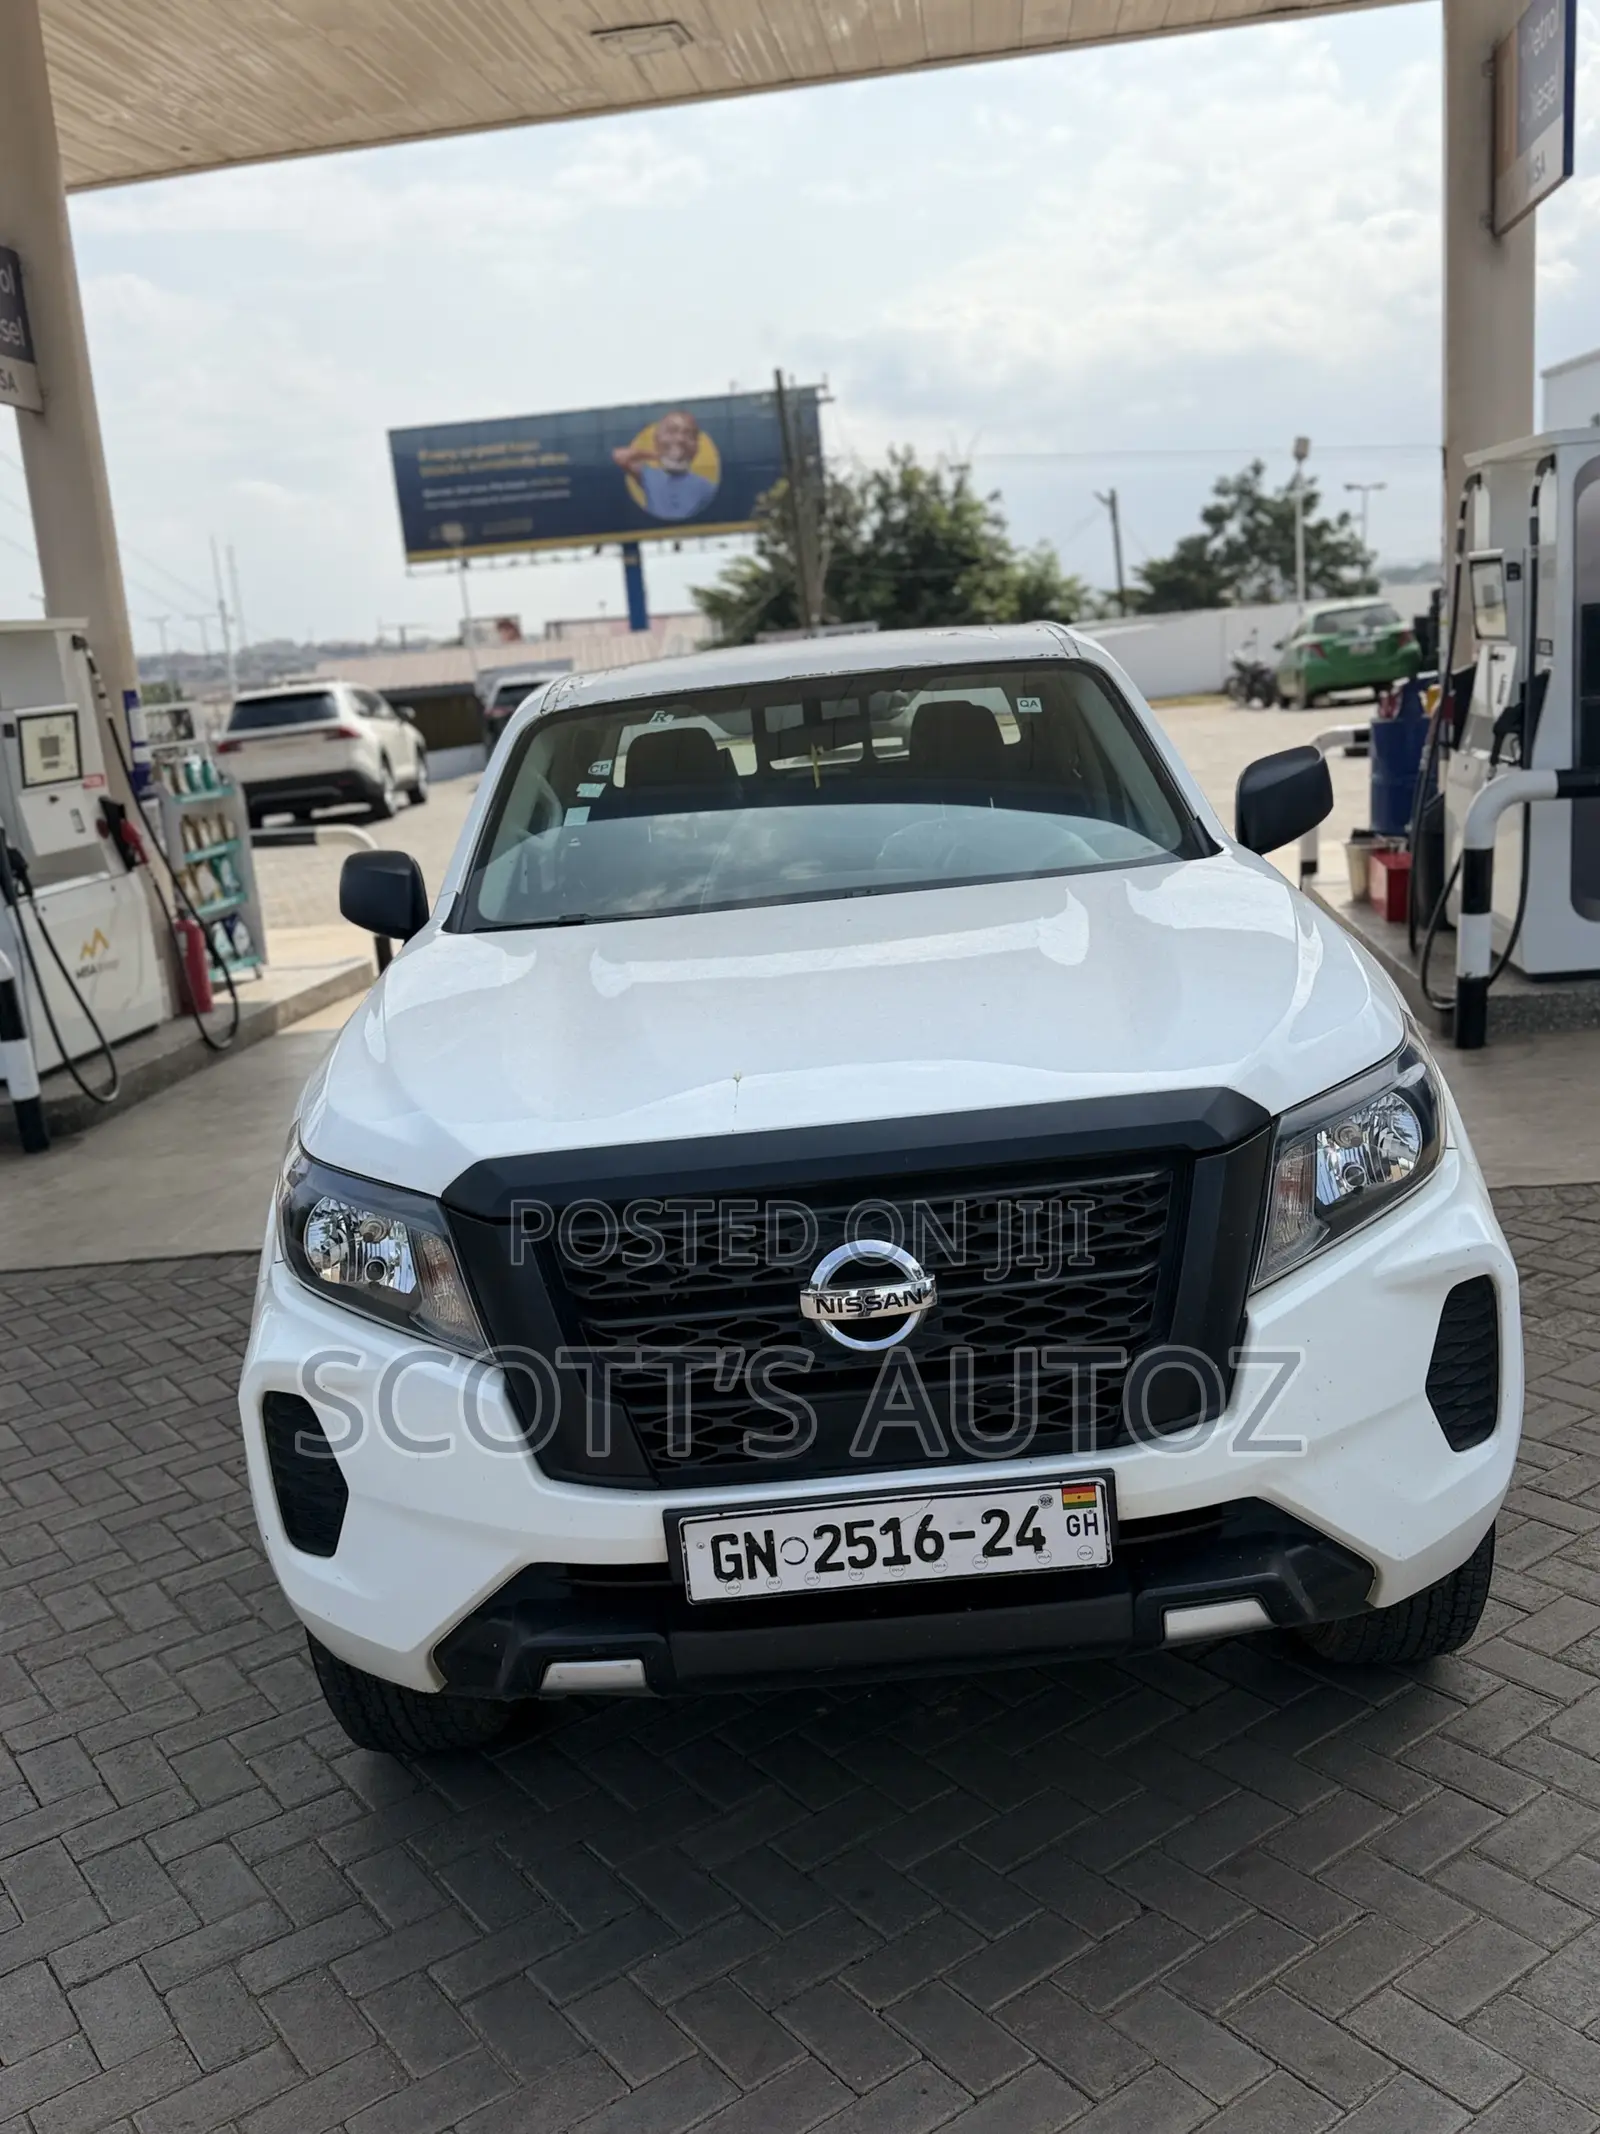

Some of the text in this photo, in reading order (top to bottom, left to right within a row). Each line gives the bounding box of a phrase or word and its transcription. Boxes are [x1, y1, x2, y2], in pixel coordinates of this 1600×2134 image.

[1020, 699, 1040, 709] QA
[815, 1288, 923, 1314] NISSAN
[1066, 1512, 1099, 1537] GH
[710, 1505, 1047, 1584] GN 2516-24
